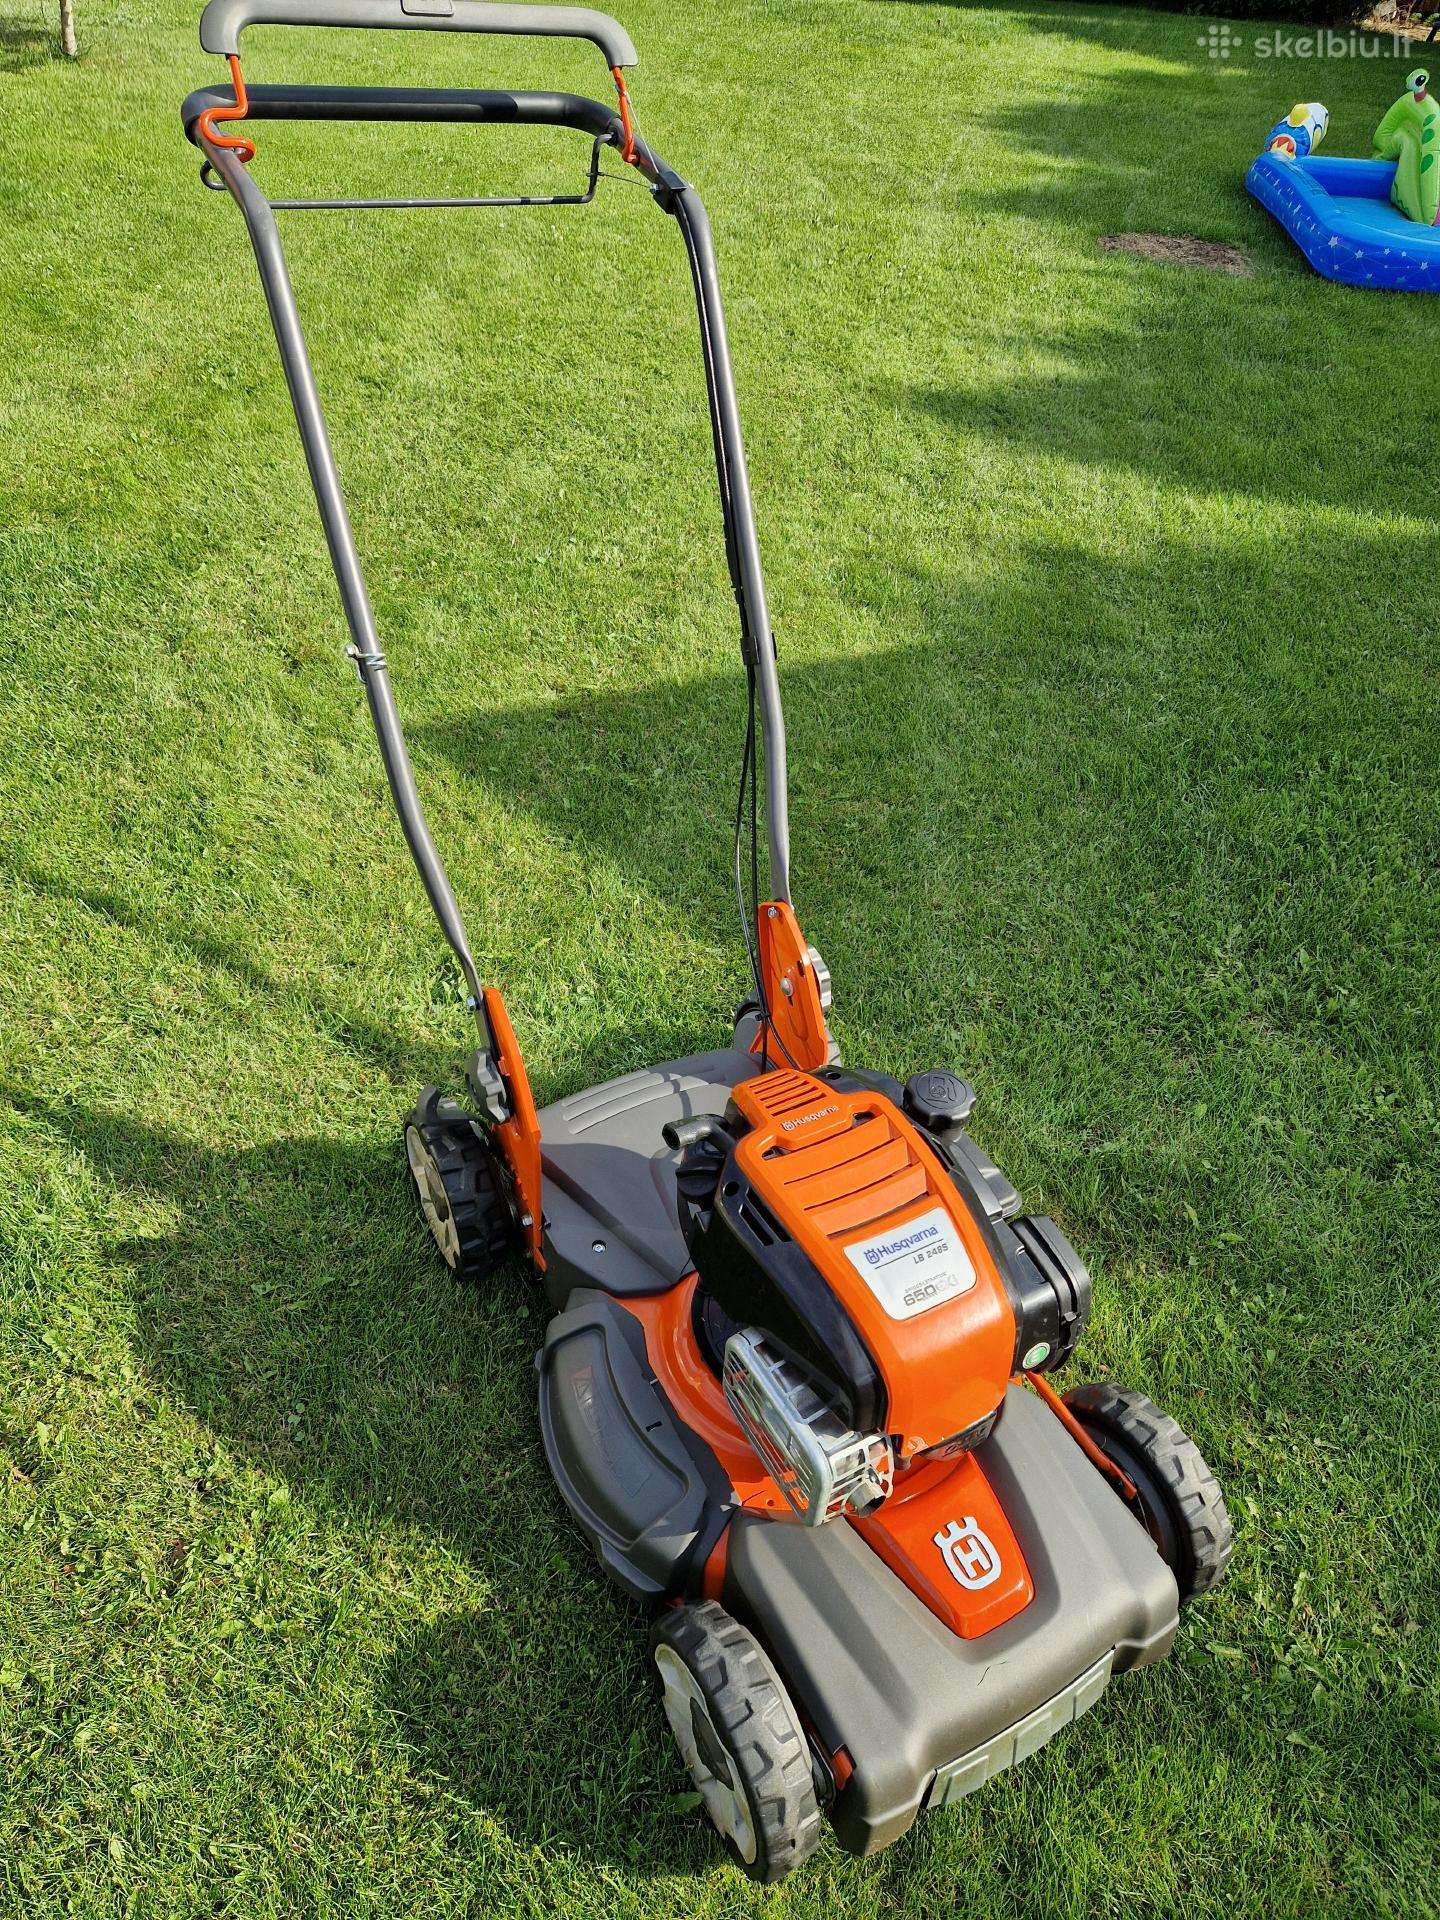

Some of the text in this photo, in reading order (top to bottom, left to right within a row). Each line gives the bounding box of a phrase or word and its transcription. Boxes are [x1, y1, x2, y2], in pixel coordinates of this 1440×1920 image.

[793, 1105, 839, 1127] Husqvarna
[877, 1226, 939, 1258] Husqvarna
[913, 1253, 925, 1265] LB
